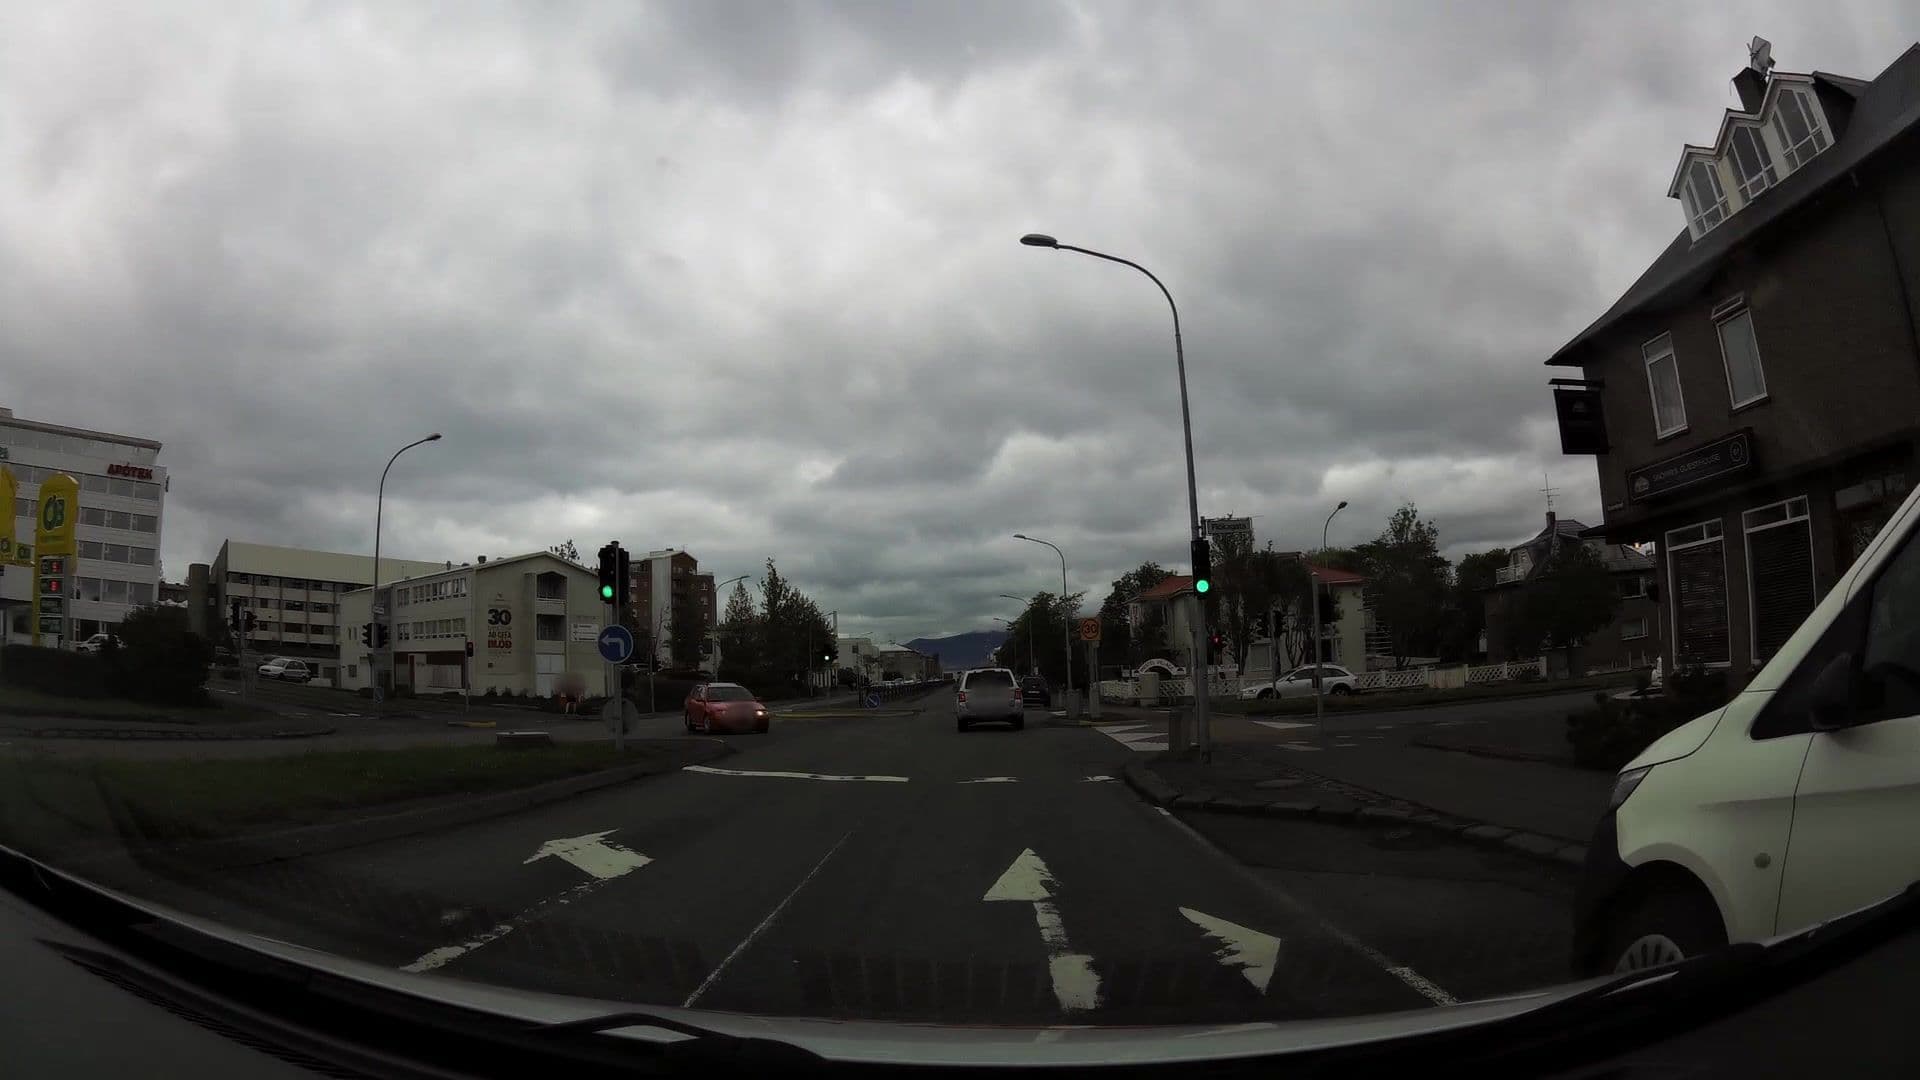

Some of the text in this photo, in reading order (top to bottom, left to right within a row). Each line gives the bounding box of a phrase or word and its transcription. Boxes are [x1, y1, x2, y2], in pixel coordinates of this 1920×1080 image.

[108, 462, 152, 480] APÓTEK
[488, 608, 512, 626] 30
[1084, 624, 1097, 634] 30
